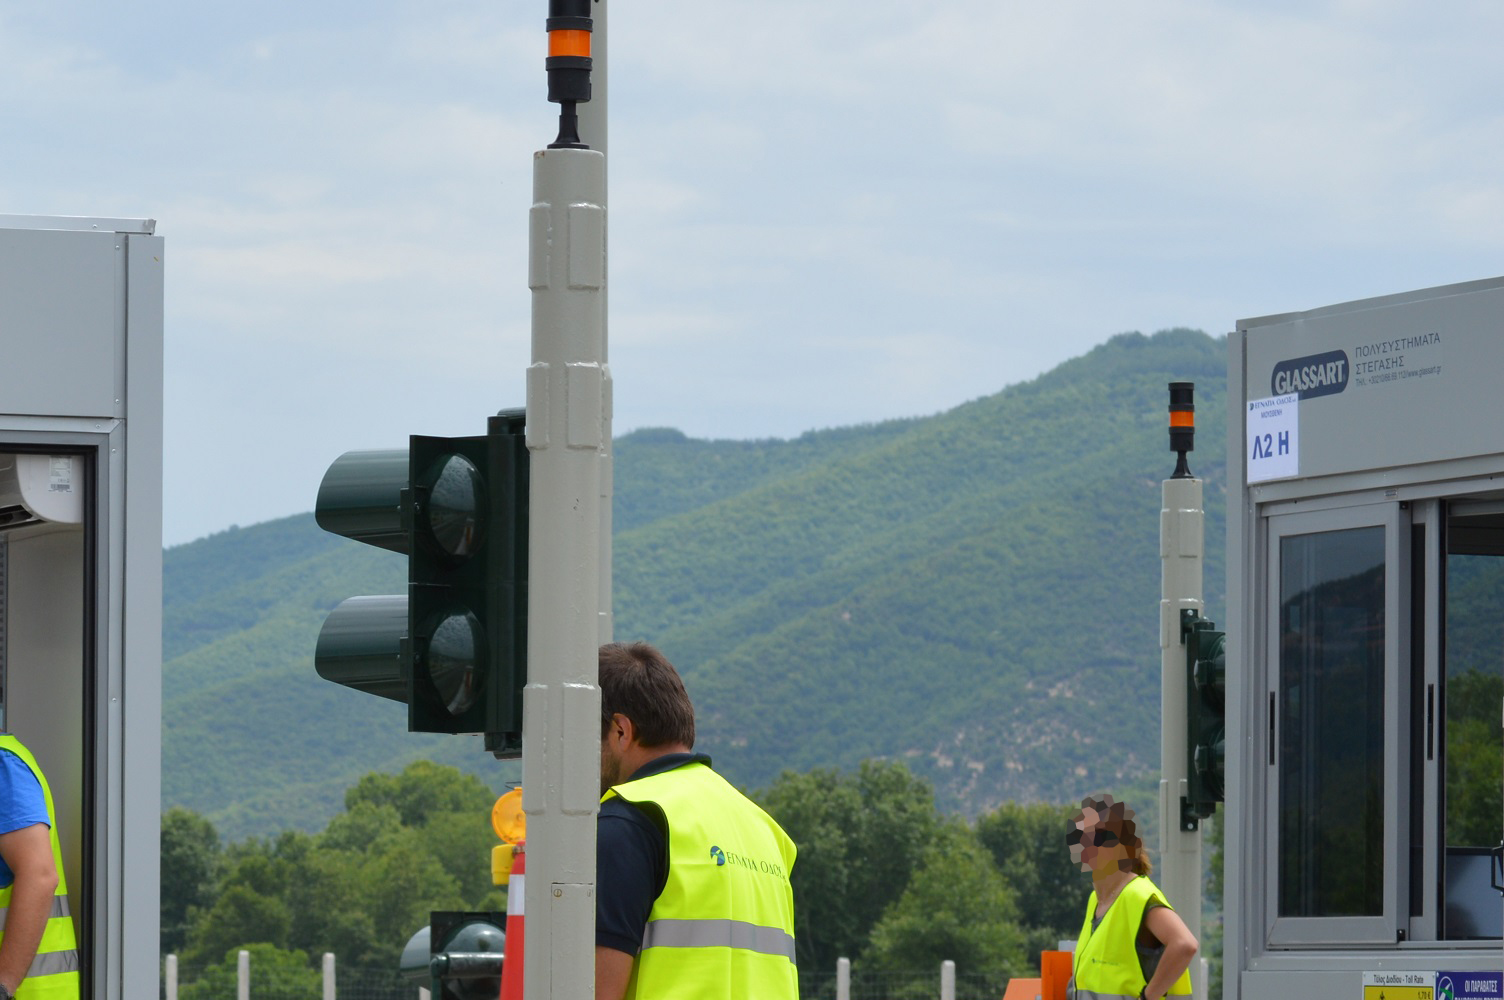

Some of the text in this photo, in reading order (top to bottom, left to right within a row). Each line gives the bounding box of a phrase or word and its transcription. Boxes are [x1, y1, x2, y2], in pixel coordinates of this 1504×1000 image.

[1355, 332, 1441, 358] ΠΟΛΥΣΥΣΤΗΜΑΤΑ
[1355, 355, 1405, 375] ΣΤΕΓΑΣΗΣ
[1471, 980, 1498, 992] ΠΑΡΑΒΑΤΕΣ
